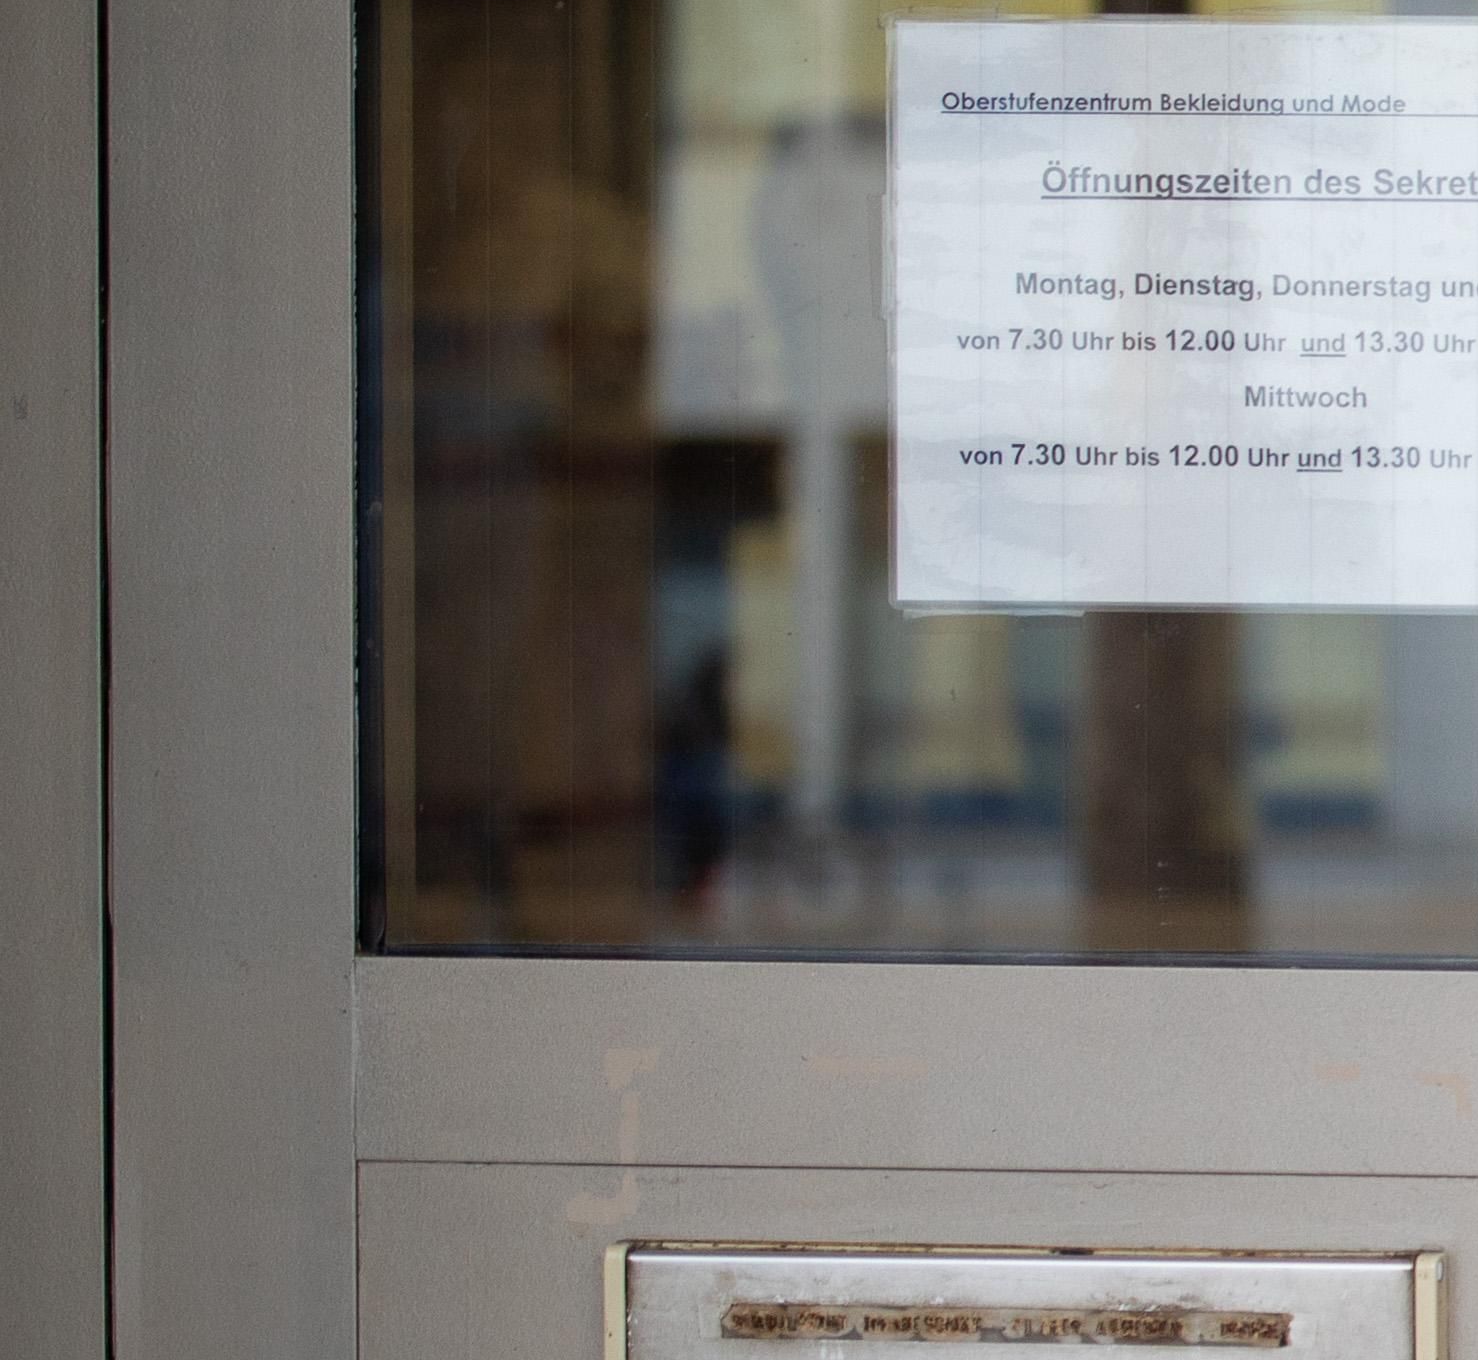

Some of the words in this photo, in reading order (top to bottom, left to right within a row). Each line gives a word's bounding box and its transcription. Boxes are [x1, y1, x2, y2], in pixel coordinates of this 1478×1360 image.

[941, 92, 1152, 111] Oberstufenzentrum
[1160, 93, 1285, 114] Bekleidung
[1292, 95, 1334, 113] und
[1341, 95, 1407, 113] Mode
[1041, 161, 1292, 198] Öffnungszeiten
[1303, 169, 1361, 195] des
[1016, 273, 1125, 300] Montag,
[1134, 273, 1263, 302] Dienstag,
[1272, 274, 1431, 302] Donnerstag
[957, 333, 1000, 351] von
[1008, 328, 1063, 351] 7.30
[1072, 331, 1114, 351] Uhr
[1122, 331, 1156, 351] bis
[1165, 329, 1235, 351] 12.00
[1244, 333, 1286, 352] Uhr
[1301, 333, 1346, 353] und
[1354, 331, 1424, 353] 13.30
[1433, 334, 1476, 353] Uhr
[1244, 386, 1367, 408] Mittwoch
[959, 448, 1003, 466] von
[1010, 443, 1065, 466] 7.30
[1075, 446, 1118, 466] Uhr
[1126, 446, 1160, 466] bis
[1168, 444, 1238, 467] 12.00
[1248, 447, 1290, 468] Uhr
[1298, 448, 1342, 468] und
[1351, 446, 1421, 469] 13.30
[1429, 449, 1472, 469] Uhr
